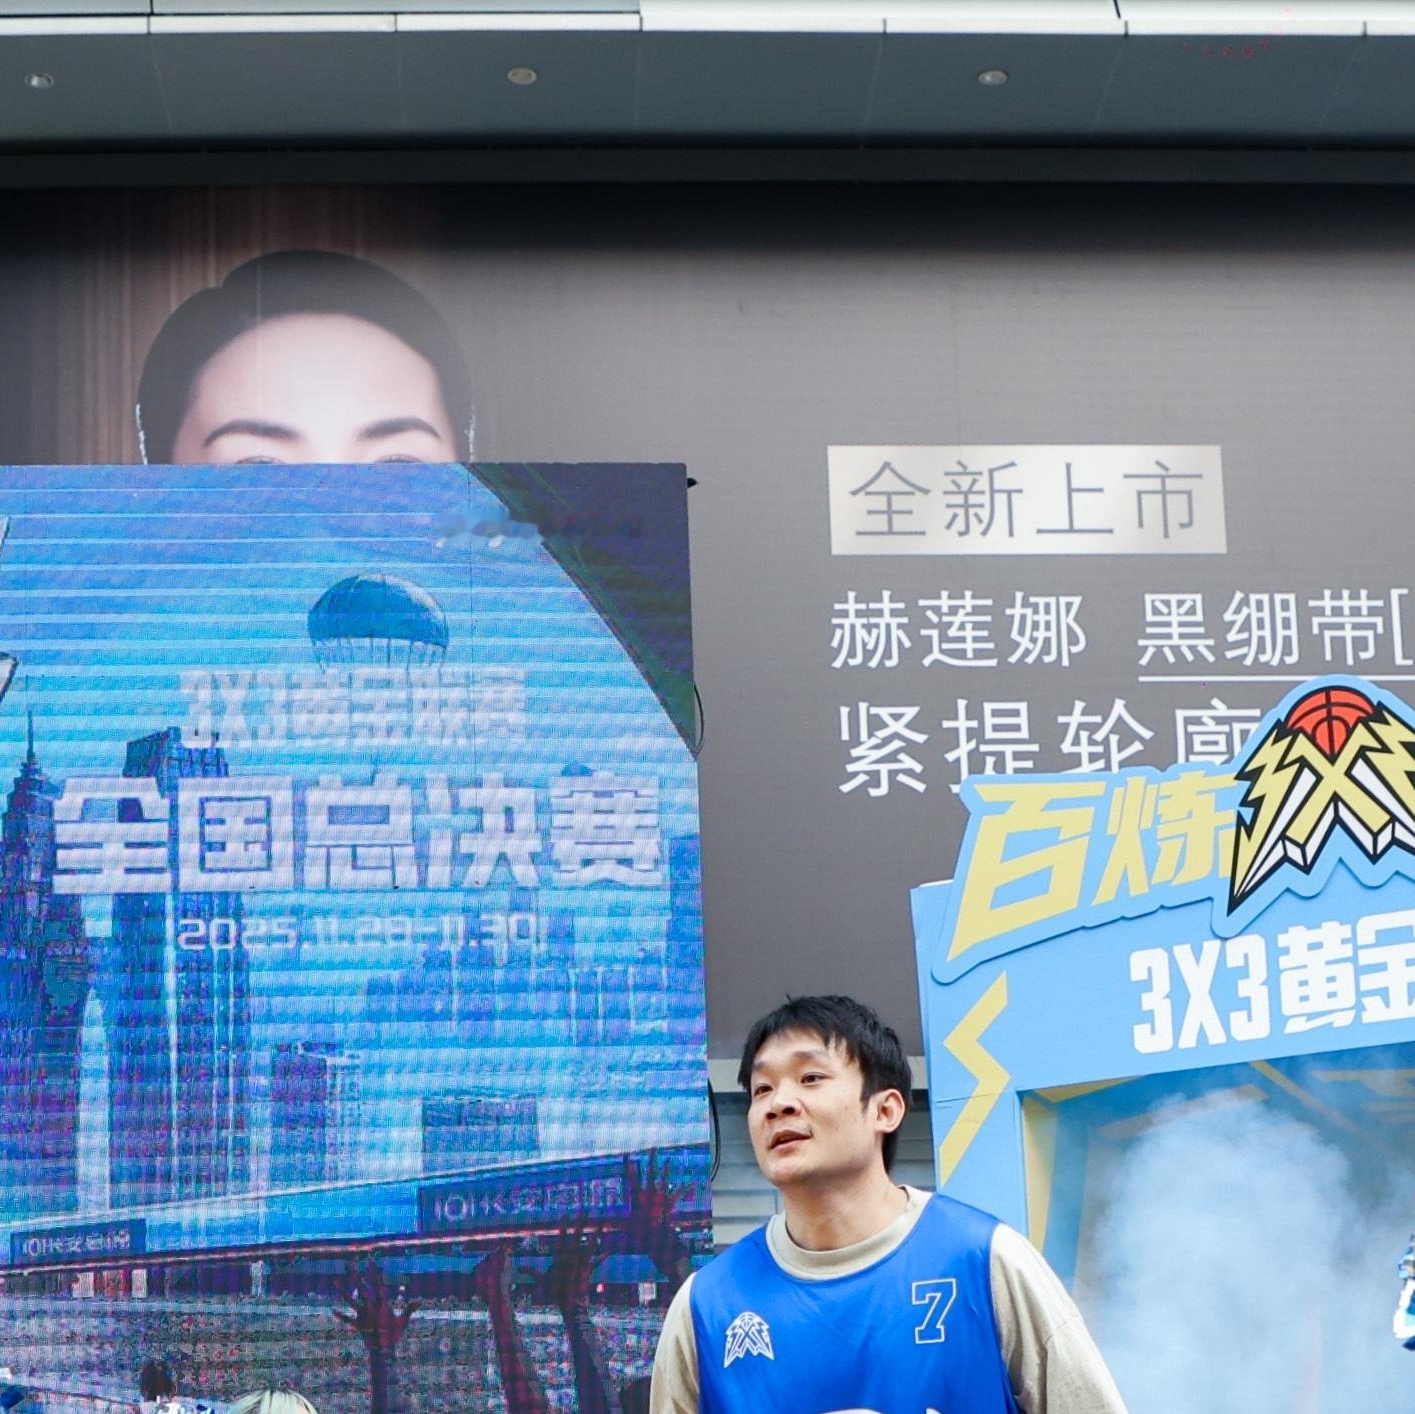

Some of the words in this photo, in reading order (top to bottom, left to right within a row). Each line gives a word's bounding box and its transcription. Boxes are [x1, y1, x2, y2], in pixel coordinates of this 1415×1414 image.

[849, 458, 1204, 540] 全新上市
[830, 589, 1086, 668] 赫莲娜
[53, 772, 663, 894] 全国总决赛
[912, 1278, 957, 1344] 7
